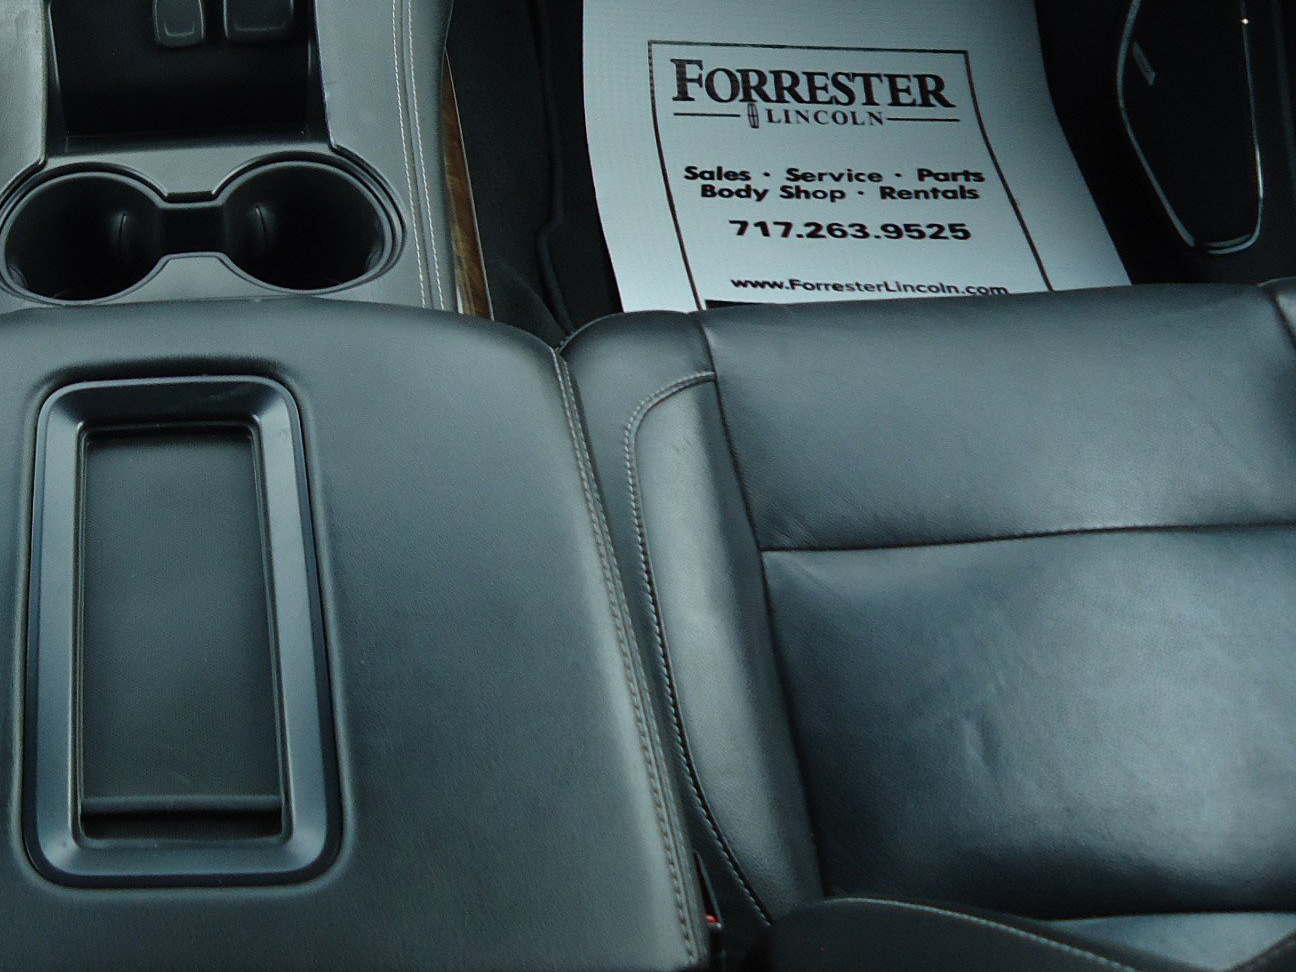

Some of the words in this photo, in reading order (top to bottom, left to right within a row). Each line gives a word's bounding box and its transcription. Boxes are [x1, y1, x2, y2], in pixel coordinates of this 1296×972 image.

[670, 58, 956, 108] FORRESTER
[765, 108, 884, 126] LINCOLN
[684, 165, 752, 181] Sales
[786, 168, 884, 183] Service
[917, 168, 986, 183] Parts
[700, 184, 769, 202] Body
[779, 185, 846, 202] Shop
[880, 185, 980, 200] Rentals
[729, 220, 972, 240] 717.263.9525
[730, 278, 1009, 296] www.ForresterLincoln.com
